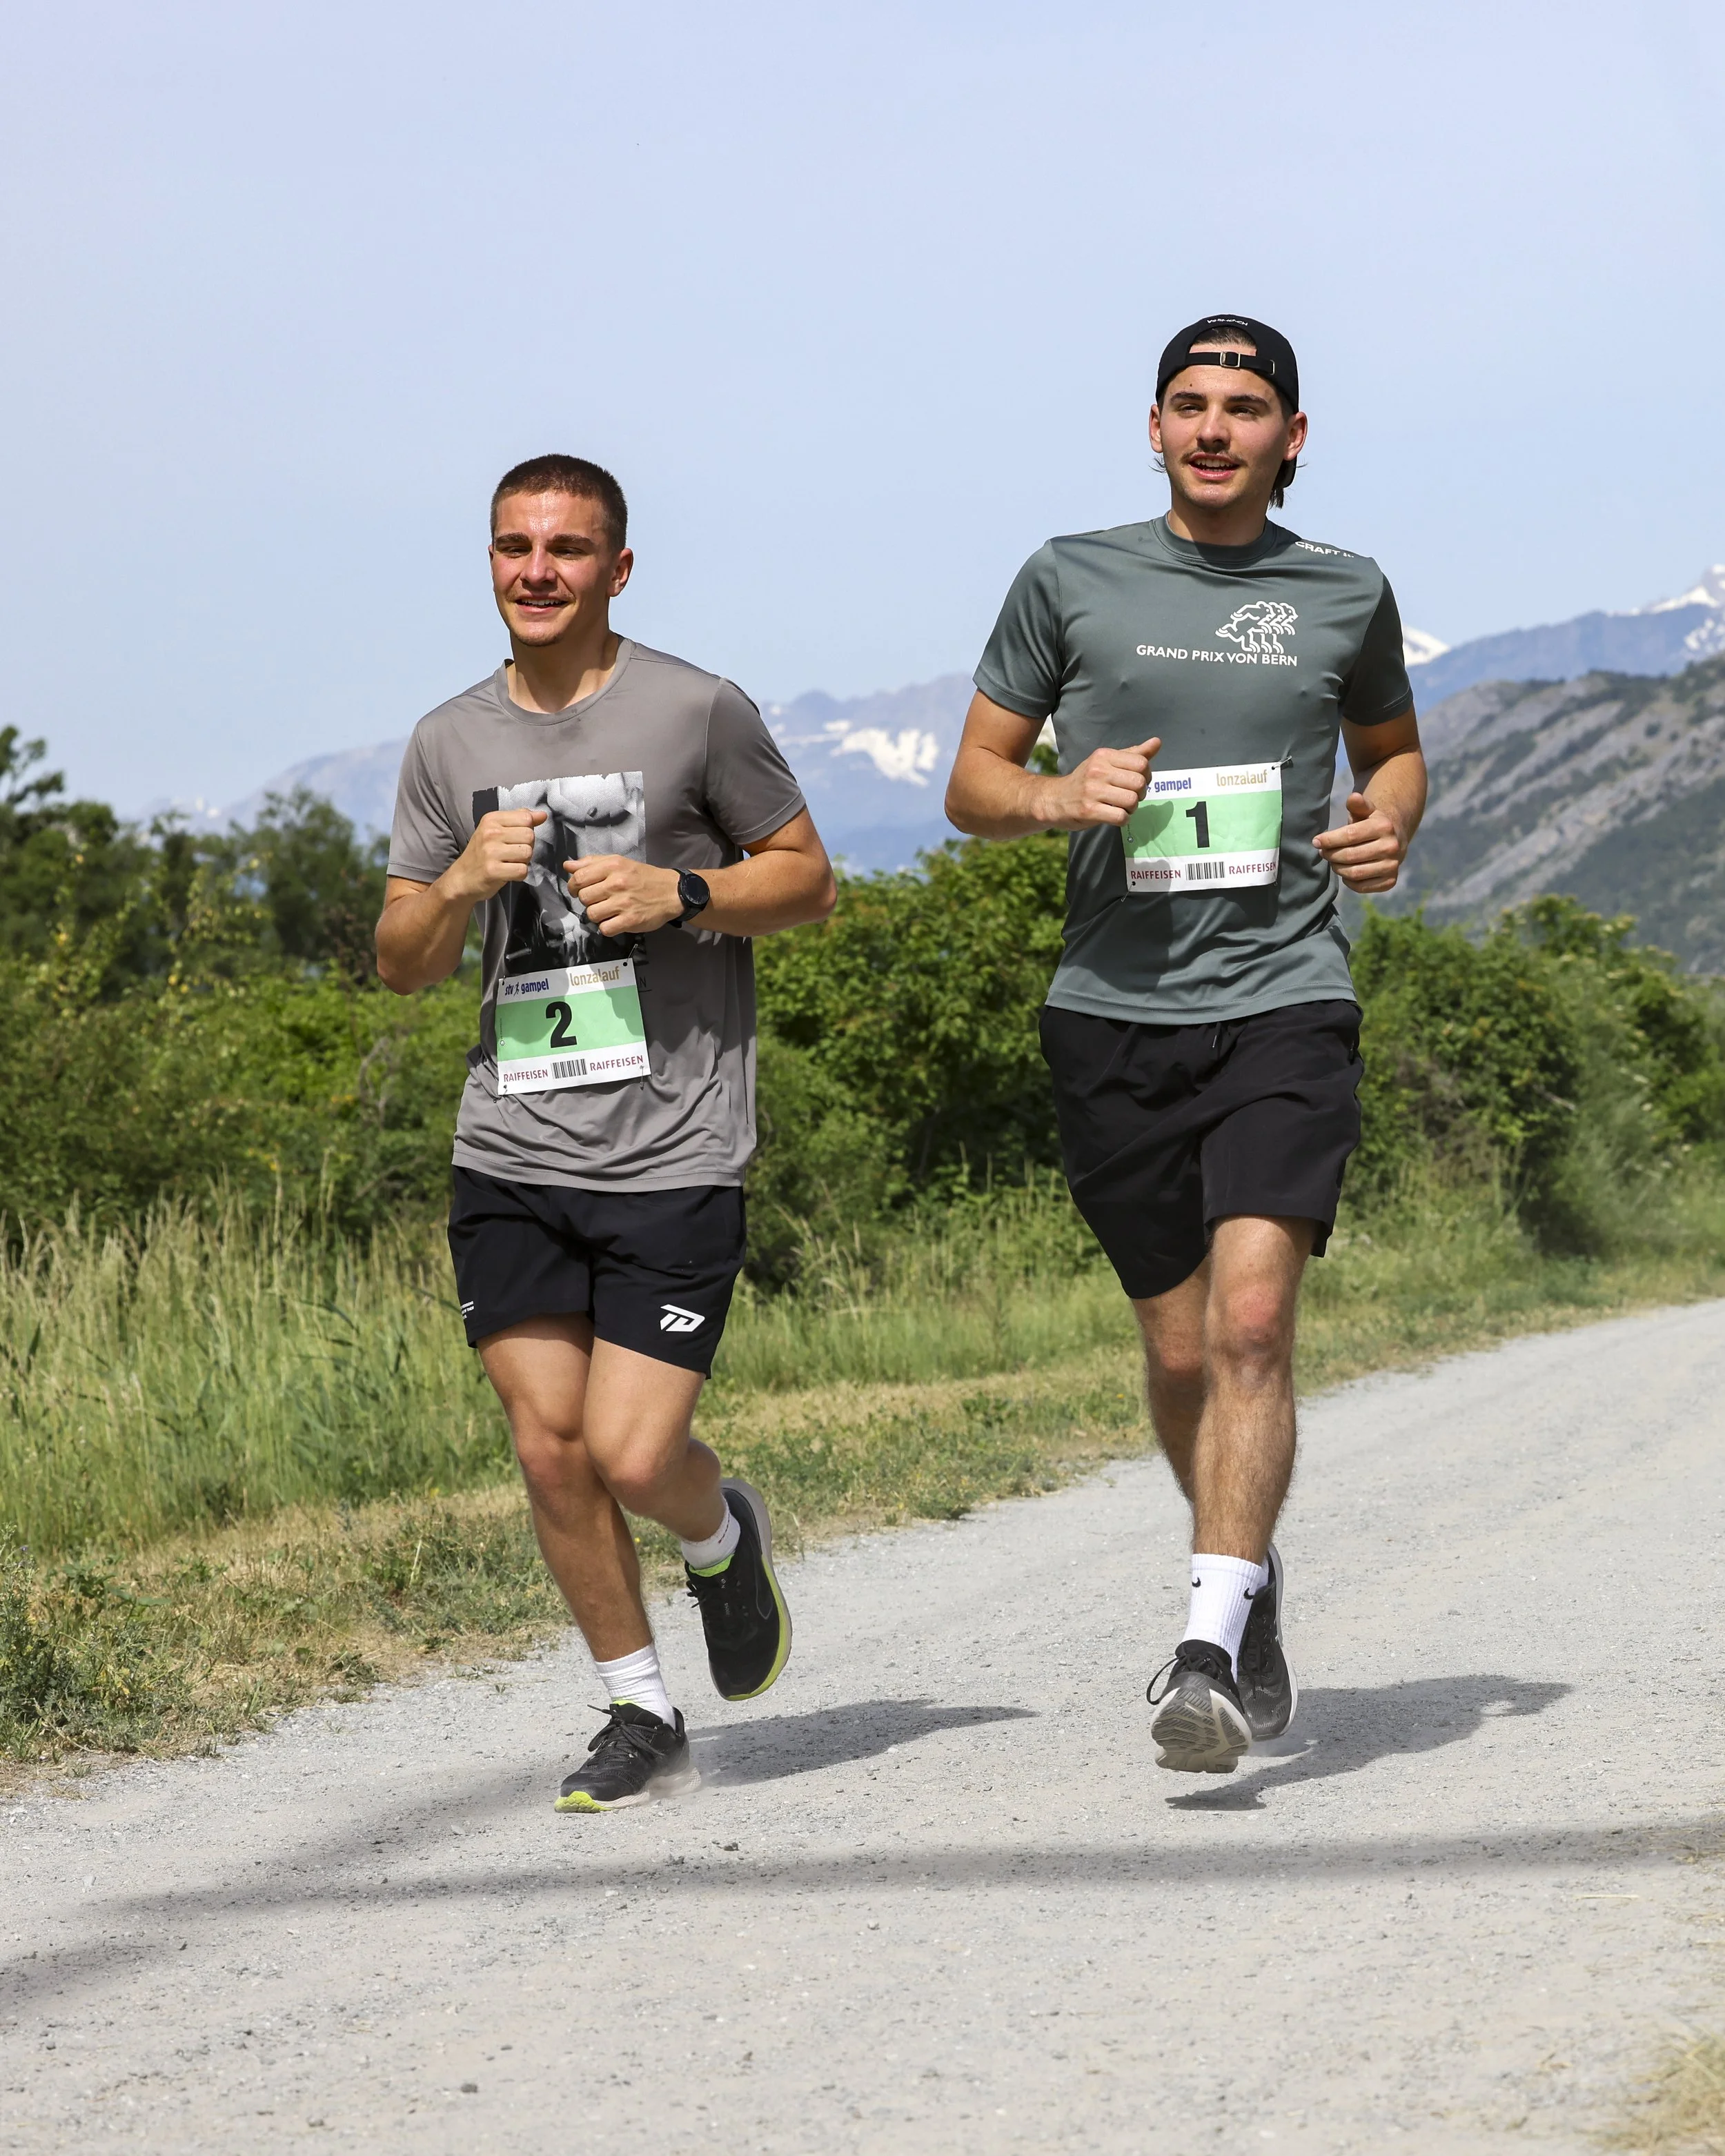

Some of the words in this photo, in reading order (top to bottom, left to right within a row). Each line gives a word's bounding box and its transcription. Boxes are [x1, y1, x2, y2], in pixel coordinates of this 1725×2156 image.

[1294, 541, 1341, 555] CRAFT
[1136, 644, 1188, 660] GRAND
[1192, 650, 1225, 662] PRIX
[1225, 653, 1257, 664] VON
[1261, 653, 1297, 666] BERN
[1154, 777, 1192, 793] gampel
[1216, 769, 1268, 787] lonzalauf
[1185, 800, 1210, 849] 1
[1130, 869, 1181, 880] RAIFFEISEN
[1229, 860, 1276, 875] RAIFFEISEN
[570, 966, 620, 987] lonzalauf
[521, 978, 549, 994] gampel
[545, 1000, 578, 1049] 2
[589, 1054, 644, 1071] RAIFFEISEN
[503, 1069, 549, 1082] RAIFFEISEN
